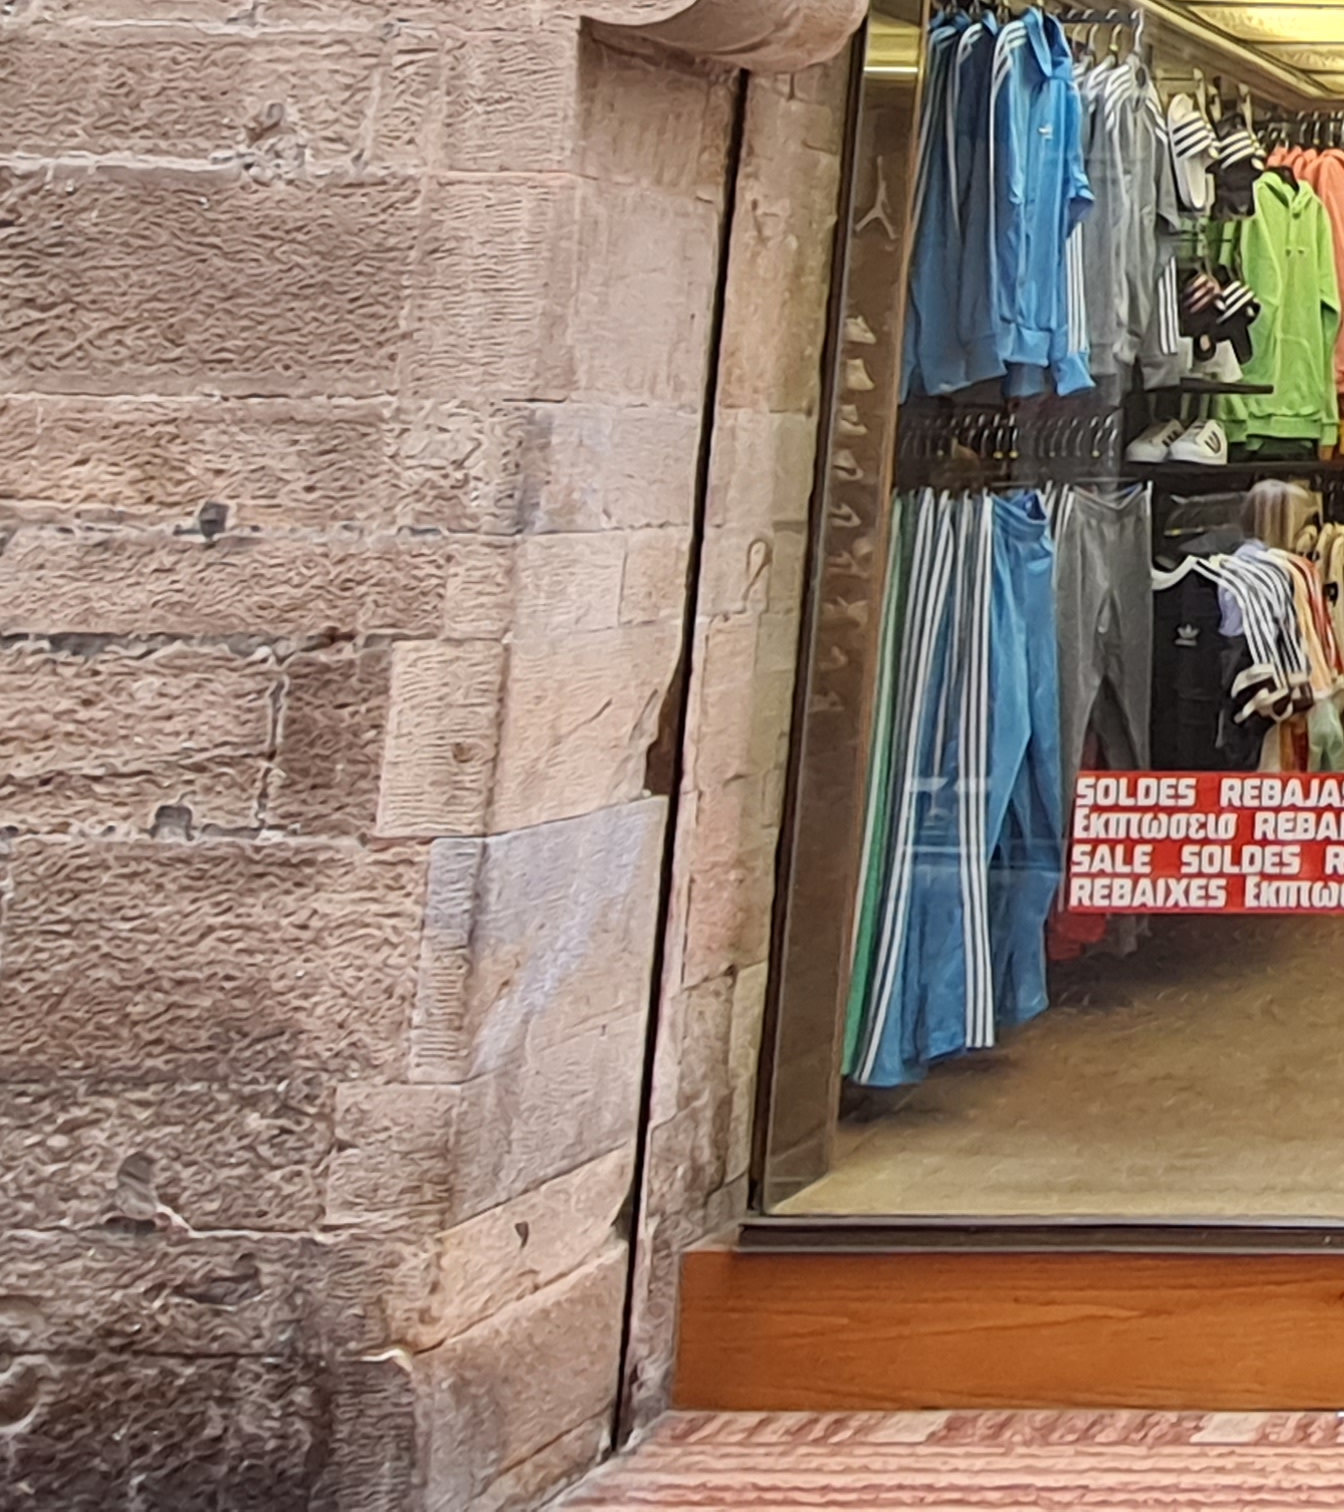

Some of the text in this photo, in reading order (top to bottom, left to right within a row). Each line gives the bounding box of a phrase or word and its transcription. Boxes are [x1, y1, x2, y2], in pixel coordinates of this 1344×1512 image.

[1074, 776, 1198, 809] SOLDES
[1070, 844, 1152, 875] SALE
[1180, 844, 1301, 876] SOLDES
[1069, 877, 1227, 909] REBAIXES
